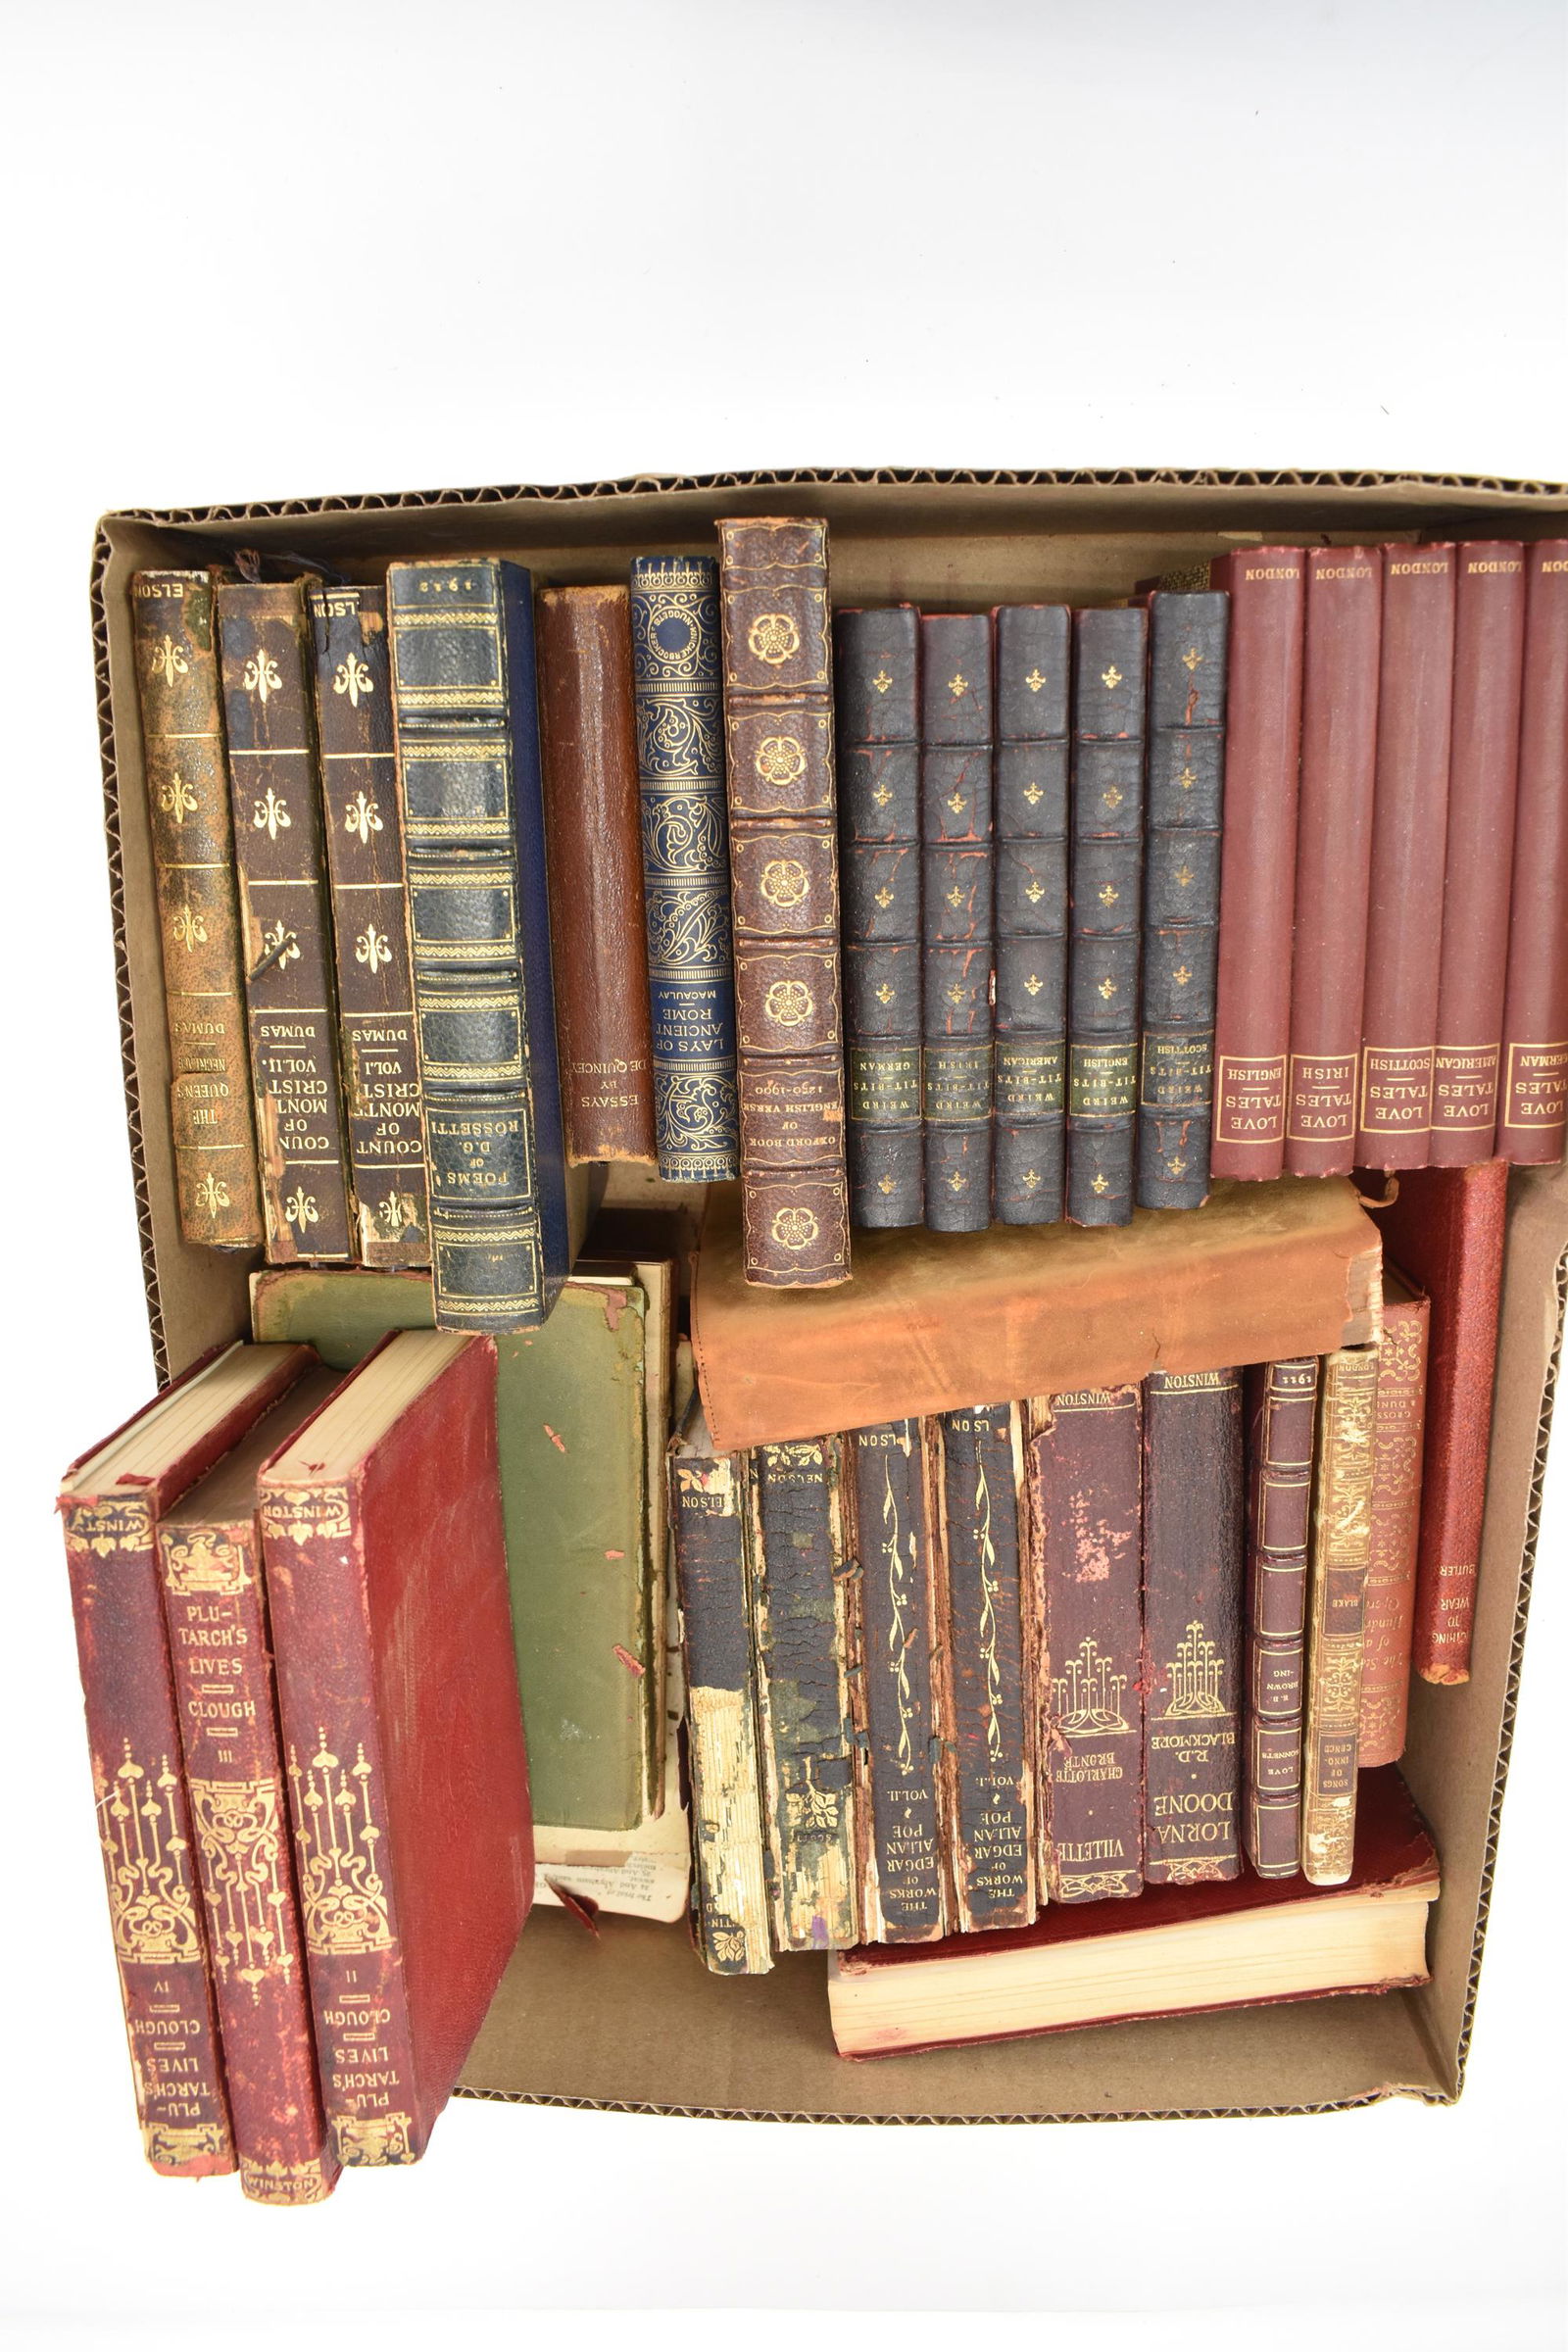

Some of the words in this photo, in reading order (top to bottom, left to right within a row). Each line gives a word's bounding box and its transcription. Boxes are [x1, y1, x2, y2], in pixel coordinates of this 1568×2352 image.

[1246, 567, 1300, 581] LONDON
[1315, 566, 1372, 580] LONDON
[1391, 562, 1449, 575] LONDON
[1468, 561, 1522, 573] LONDON
[134, 583, 184, 598] ELSON
[314, 602, 357, 618] LSON
[653, 610, 693, 626] NUGGETS
[650, 625, 698, 661] KNICKERBOCKER
[658, 989, 717, 1001] MACAULAY
[662, 1007, 711, 1021] ROME
[174, 1022, 225, 1035] DUMAS
[260, 1025, 316, 1039] DUMAS
[351, 1028, 408, 1043] DUMAS
[656, 1022, 723, 1037] ANCIENT
[656, 1039, 674, 1053] OF
[678, 1039, 723, 1053] LAYS
[1157, 1043, 1208, 1055] SCOTTISH
[571, 1059, 627, 1074] QUINCEY
[629, 1058, 646, 1071] DE
[859, 1060, 911, 1071] GERMAN
[938, 1059, 980, 1070] IRISH
[1003, 1055, 1058, 1067] AMERICAN
[1083, 1056, 1129, 1068] ENGLISH
[1370, 1057, 1431, 1071] SCOTTISH
[1436, 1055, 1497, 1069] AMERICAN
[1520, 1054, 1568, 1067] GERMAN
[365, 1061, 402, 1075] VOL.I
[1150, 1063, 1212, 1077] TIT-BITS
[1227, 1067, 1282, 1080] ENGLISH
[1302, 1065, 1349, 1080] IRISH
[600, 1079, 616, 1090] BY
[997, 1072, 1062, 1085] TIT-BITS
[1073, 1075, 1137, 1088] TIT-BITS
[176, 1082, 229, 1100] QUEEN'S
[268, 1079, 328, 1095] CRIST
[359, 1083, 420, 1099] CRIST
[754, 1081, 823, 1097] 1250-1900
[852, 1080, 918, 1093] TIT-BITS
[927, 1080, 991, 1093] TIT-BITS
[1157, 1084, 1203, 1096] WEIRD
[1370, 1085, 1428, 1100] TALES
[1438, 1083, 1494, 1099] TALES
[1515, 1079, 1568, 1095] TALES
[580, 1095, 639, 1107] ESSAYS
[862, 1099, 909, 1110] WEIRD
[935, 1099, 982, 1110] WEIRD
[1007, 1092, 1054, 1103] WEIRD
[1083, 1095, 1129, 1106] WEIRD
[1225, 1095, 1281, 1109] TALES
[1296, 1093, 1352, 1107] TALES
[275, 1098, 328, 1114] MONT
[742, 1102, 781, 1113] VERSE
[785, 1101, 838, 1113] ENGLISH
[1375, 1105, 1423, 1120] LOVE
[1444, 1102, 1489, 1117] LOVE
[1520, 1100, 1564, 1115] LOVE
[192, 1108, 218, 1125] THE
[1230, 1115, 1278, 1130] LOVE
[1299, 1114, 1347, 1128] LOVE
[283, 1118, 308, 1132] OF
[375, 1122, 400, 1136] OF
[430, 1119, 518, 1137] ROSSETTI
[781, 1120, 798, 1131] OF
[278, 1136, 330, 1151] COUN
[356, 1140, 422, 1154] COUNT
[458, 1141, 490, 1153] D.G.
[749, 1136, 782, 1148] BOOK
[786, 1136, 836, 1148] OXFORD
[469, 1157, 484, 1168] OF
[446, 1171, 508, 1185] POEMS
[1164, 1372, 1220, 1388] WINSTON
[1056, 1393, 1111, 1406] WINSTON
[1377, 1410, 1411, 1420] GROSS
[952, 1419, 990, 1432] LSON
[858, 1434, 897, 1447] LSON
[767, 1473, 823, 1485] NELSON
[681, 1495, 723, 1509] ELSON
[262, 1505, 341, 1520] WINSTON
[85, 1519, 143, 1532] WINST
[1439, 1563, 1476, 1577] BUTLER
[1331, 1598, 1358, 1608] BLAKE
[1440, 1596, 1470, 1611] WEAR
[186, 1604, 232, 1622] PLU-
[1447, 1615, 1459, 1628] TO
[178, 1623, 248, 1646] TARCH'S
[1431, 1631, 1468, 1645] OTHING
[1376, 1635, 1390, 1652] of
[188, 1656, 243, 1675] LIVES
[1273, 1669, 1295, 1678] -ING
[1266, 1681, 1298, 1690] BROWN
[187, 1700, 256, 1719] CLOUGH
[1152, 1732, 1236, 1749] BLACKMORE
[1262, 1749, 1299, 1760] SONNETS
[1323, 1743, 1352, 1753] CENCE
[218, 1749, 233, 1763] III
[1174, 1748, 1208, 1763] R.D.
[1324, 1755, 1349, 1765] INNO-
[1055, 1766, 1123, 1782] CHARLOTTE
[1267, 1766, 1294, 1775] LOVE
[1322, 1779, 1348, 1788] SONGS
[887, 1788, 929, 1802] VOL.II.
[1152, 1790, 1234, 1816] DOONE
[980, 1810, 1011, 1824] POE
[893, 1824, 923, 1839] POE
[973, 1826, 1022, 1841] ALLAN
[1155, 1821, 1230, 1844] LORNA
[886, 1838, 934, 1855] ALLAN
[974, 1844, 1022, 1859] EDGAR
[1056, 1838, 1125, 1861] VILLETTE
[886, 1856, 935, 1873] EDGAR
[992, 1862, 1006, 1872] OF
[906, 1876, 919, 1886] OF
[976, 1874, 1023, 1886] WORKS
[889, 1887, 936, 1900] WORKS
[988, 1887, 1014, 1898] THE
[901, 1901, 928, 1912] THE
[345, 1970, 358, 1983] II
[153, 1981, 170, 1993] IV
[322, 2008, 391, 2026] CLOUGH
[133, 2019, 201, 2034] CLOUGH
[333, 2045, 388, 2062] LIVES
[145, 2057, 199, 2073] LIVES
[331, 2073, 400, 2092] TARCH'S
[143, 2082, 211, 2101] TARCH'S
[345, 2091, 390, 2106] PLU-
[155, 2102, 200, 2117] PLU-
[248, 2177, 314, 2190] WINSTON
